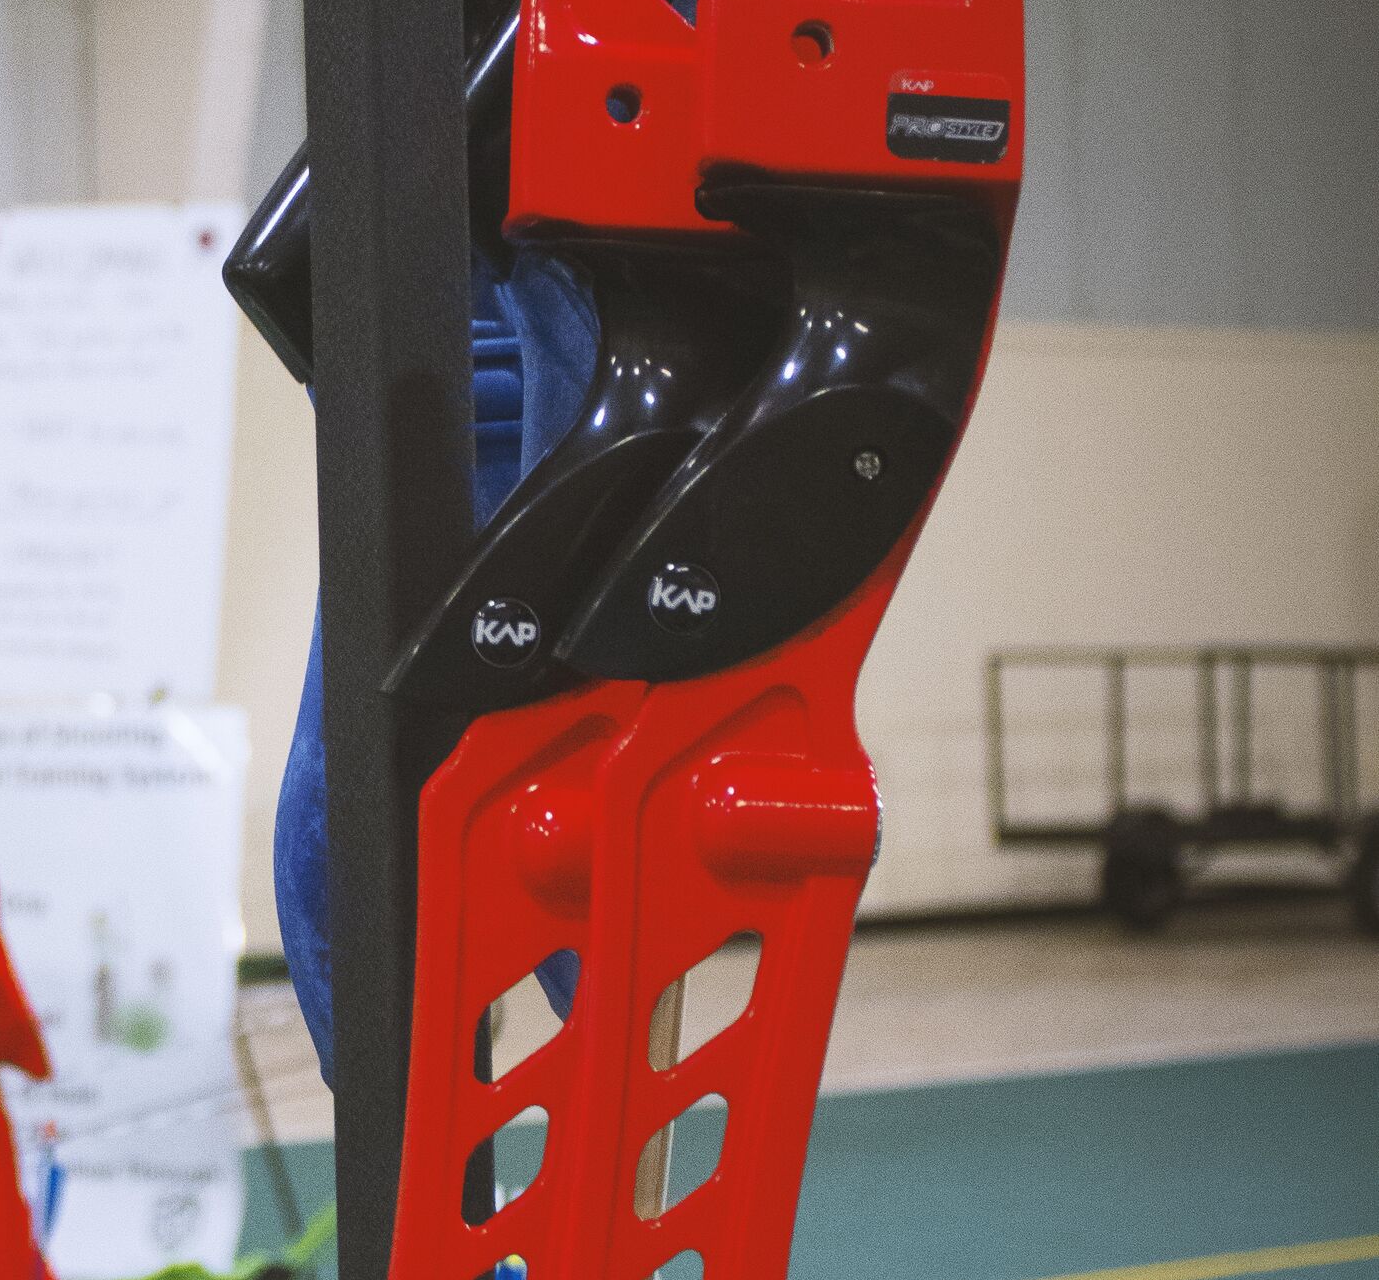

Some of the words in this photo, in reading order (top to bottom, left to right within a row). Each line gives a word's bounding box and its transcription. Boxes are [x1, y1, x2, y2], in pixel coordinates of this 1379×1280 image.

[901, 78, 935, 92] KAP
[651, 577, 716, 615] KAP
[474, 613, 537, 647] KAP
